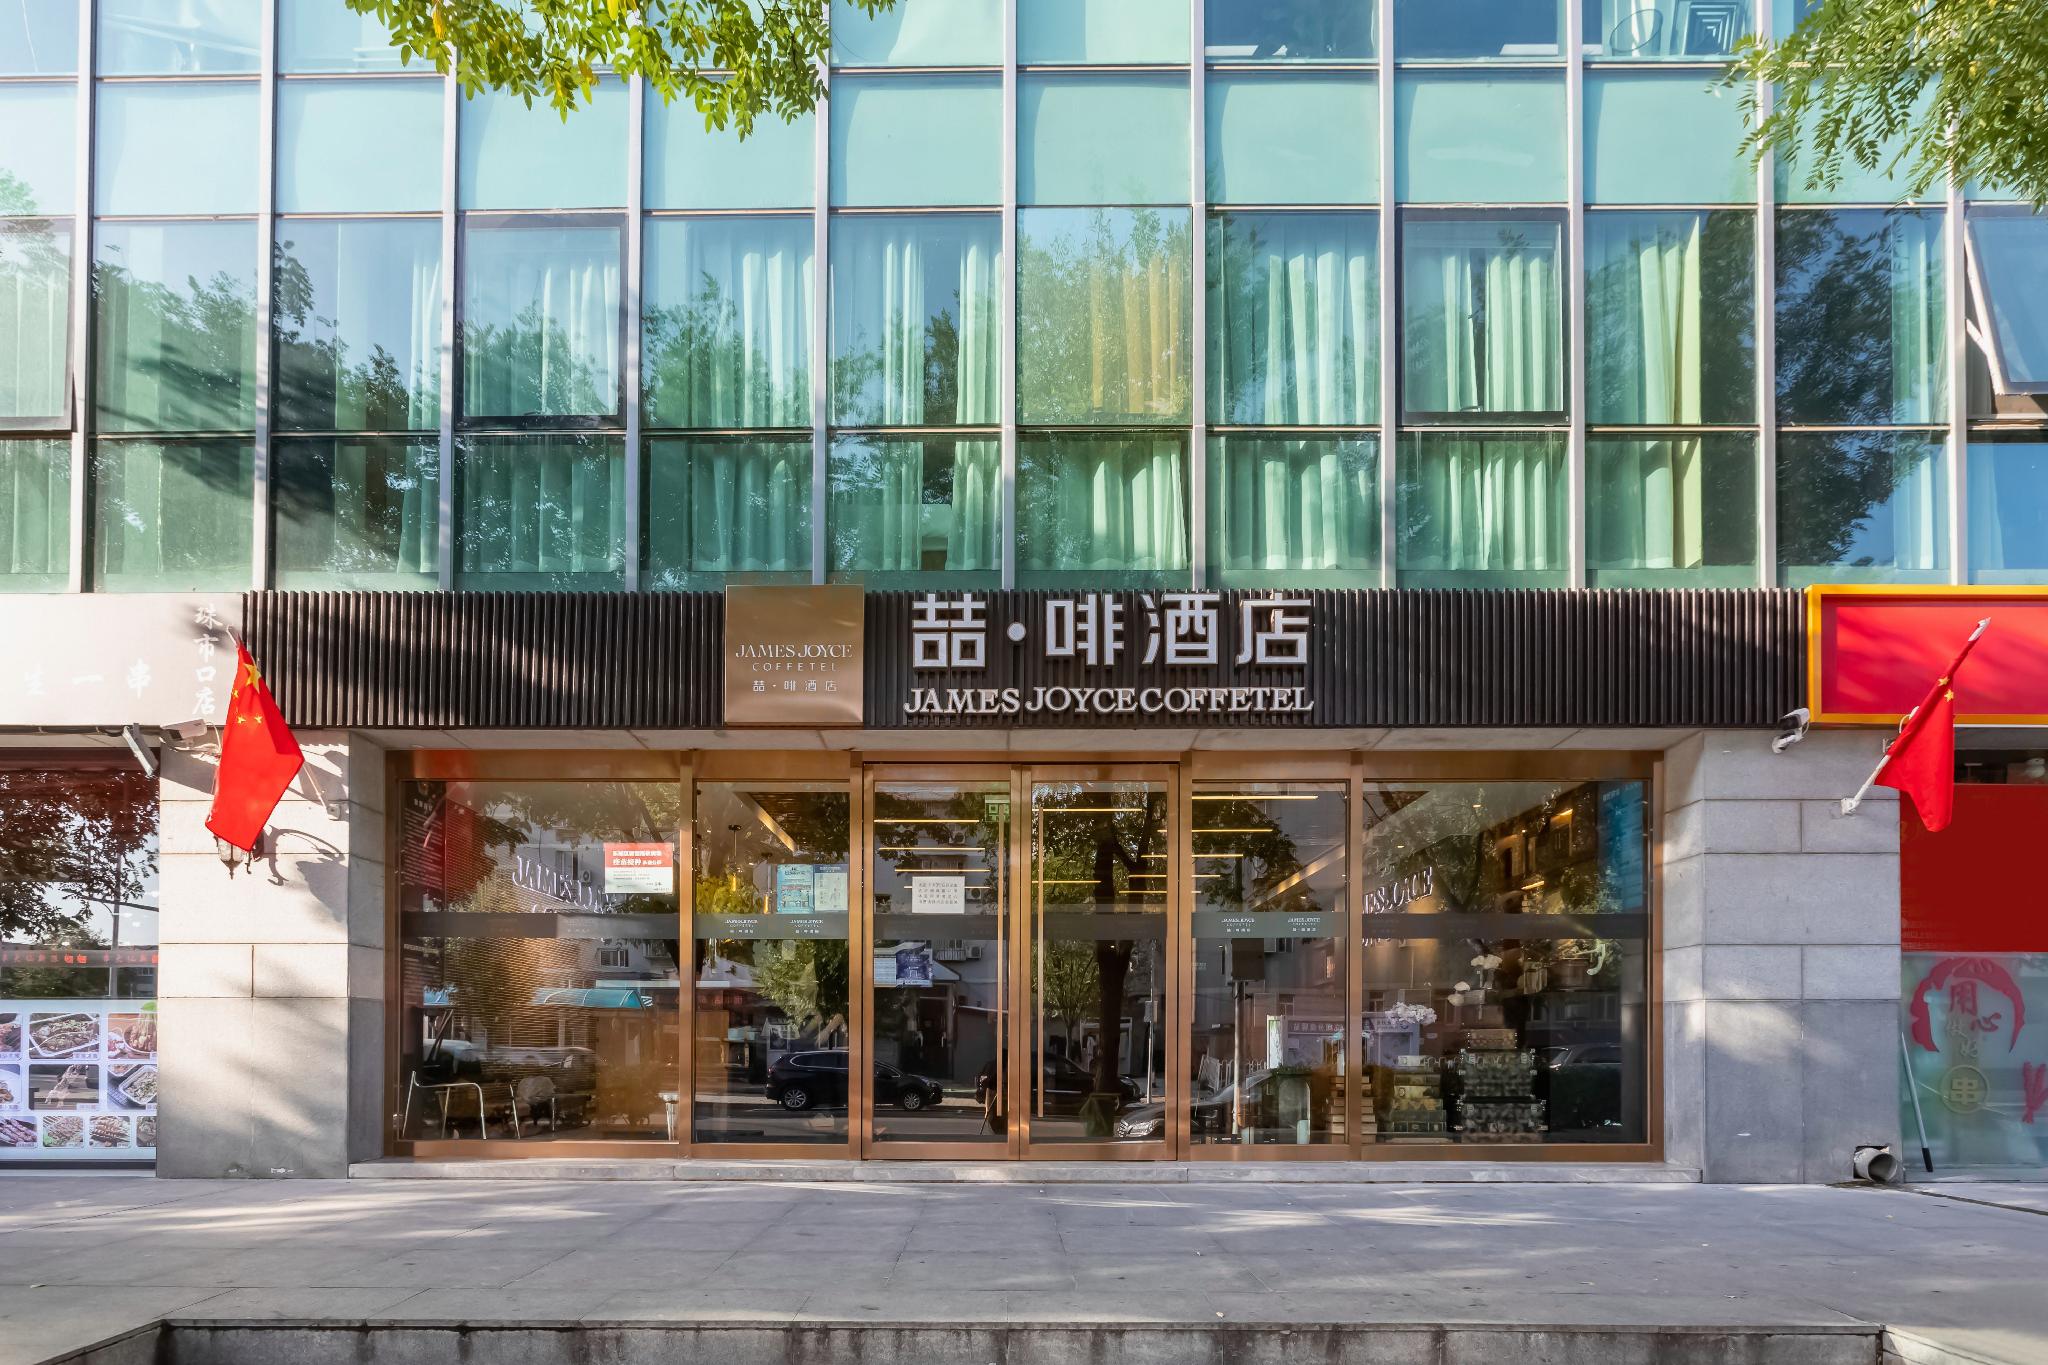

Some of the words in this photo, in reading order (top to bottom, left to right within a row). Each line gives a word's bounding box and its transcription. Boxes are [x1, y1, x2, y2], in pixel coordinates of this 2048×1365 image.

[193, 603, 223, 716] 珠市口店
[735, 644, 796, 659] JAMES
[797, 644, 853, 659] JOYCE
[752, 662, 837, 672] COFFETEL
[903, 686, 1021, 715] JAMES
[1025, 686, 1138, 714] JOYCE
[1139, 686, 1314, 714] COFFETEL
